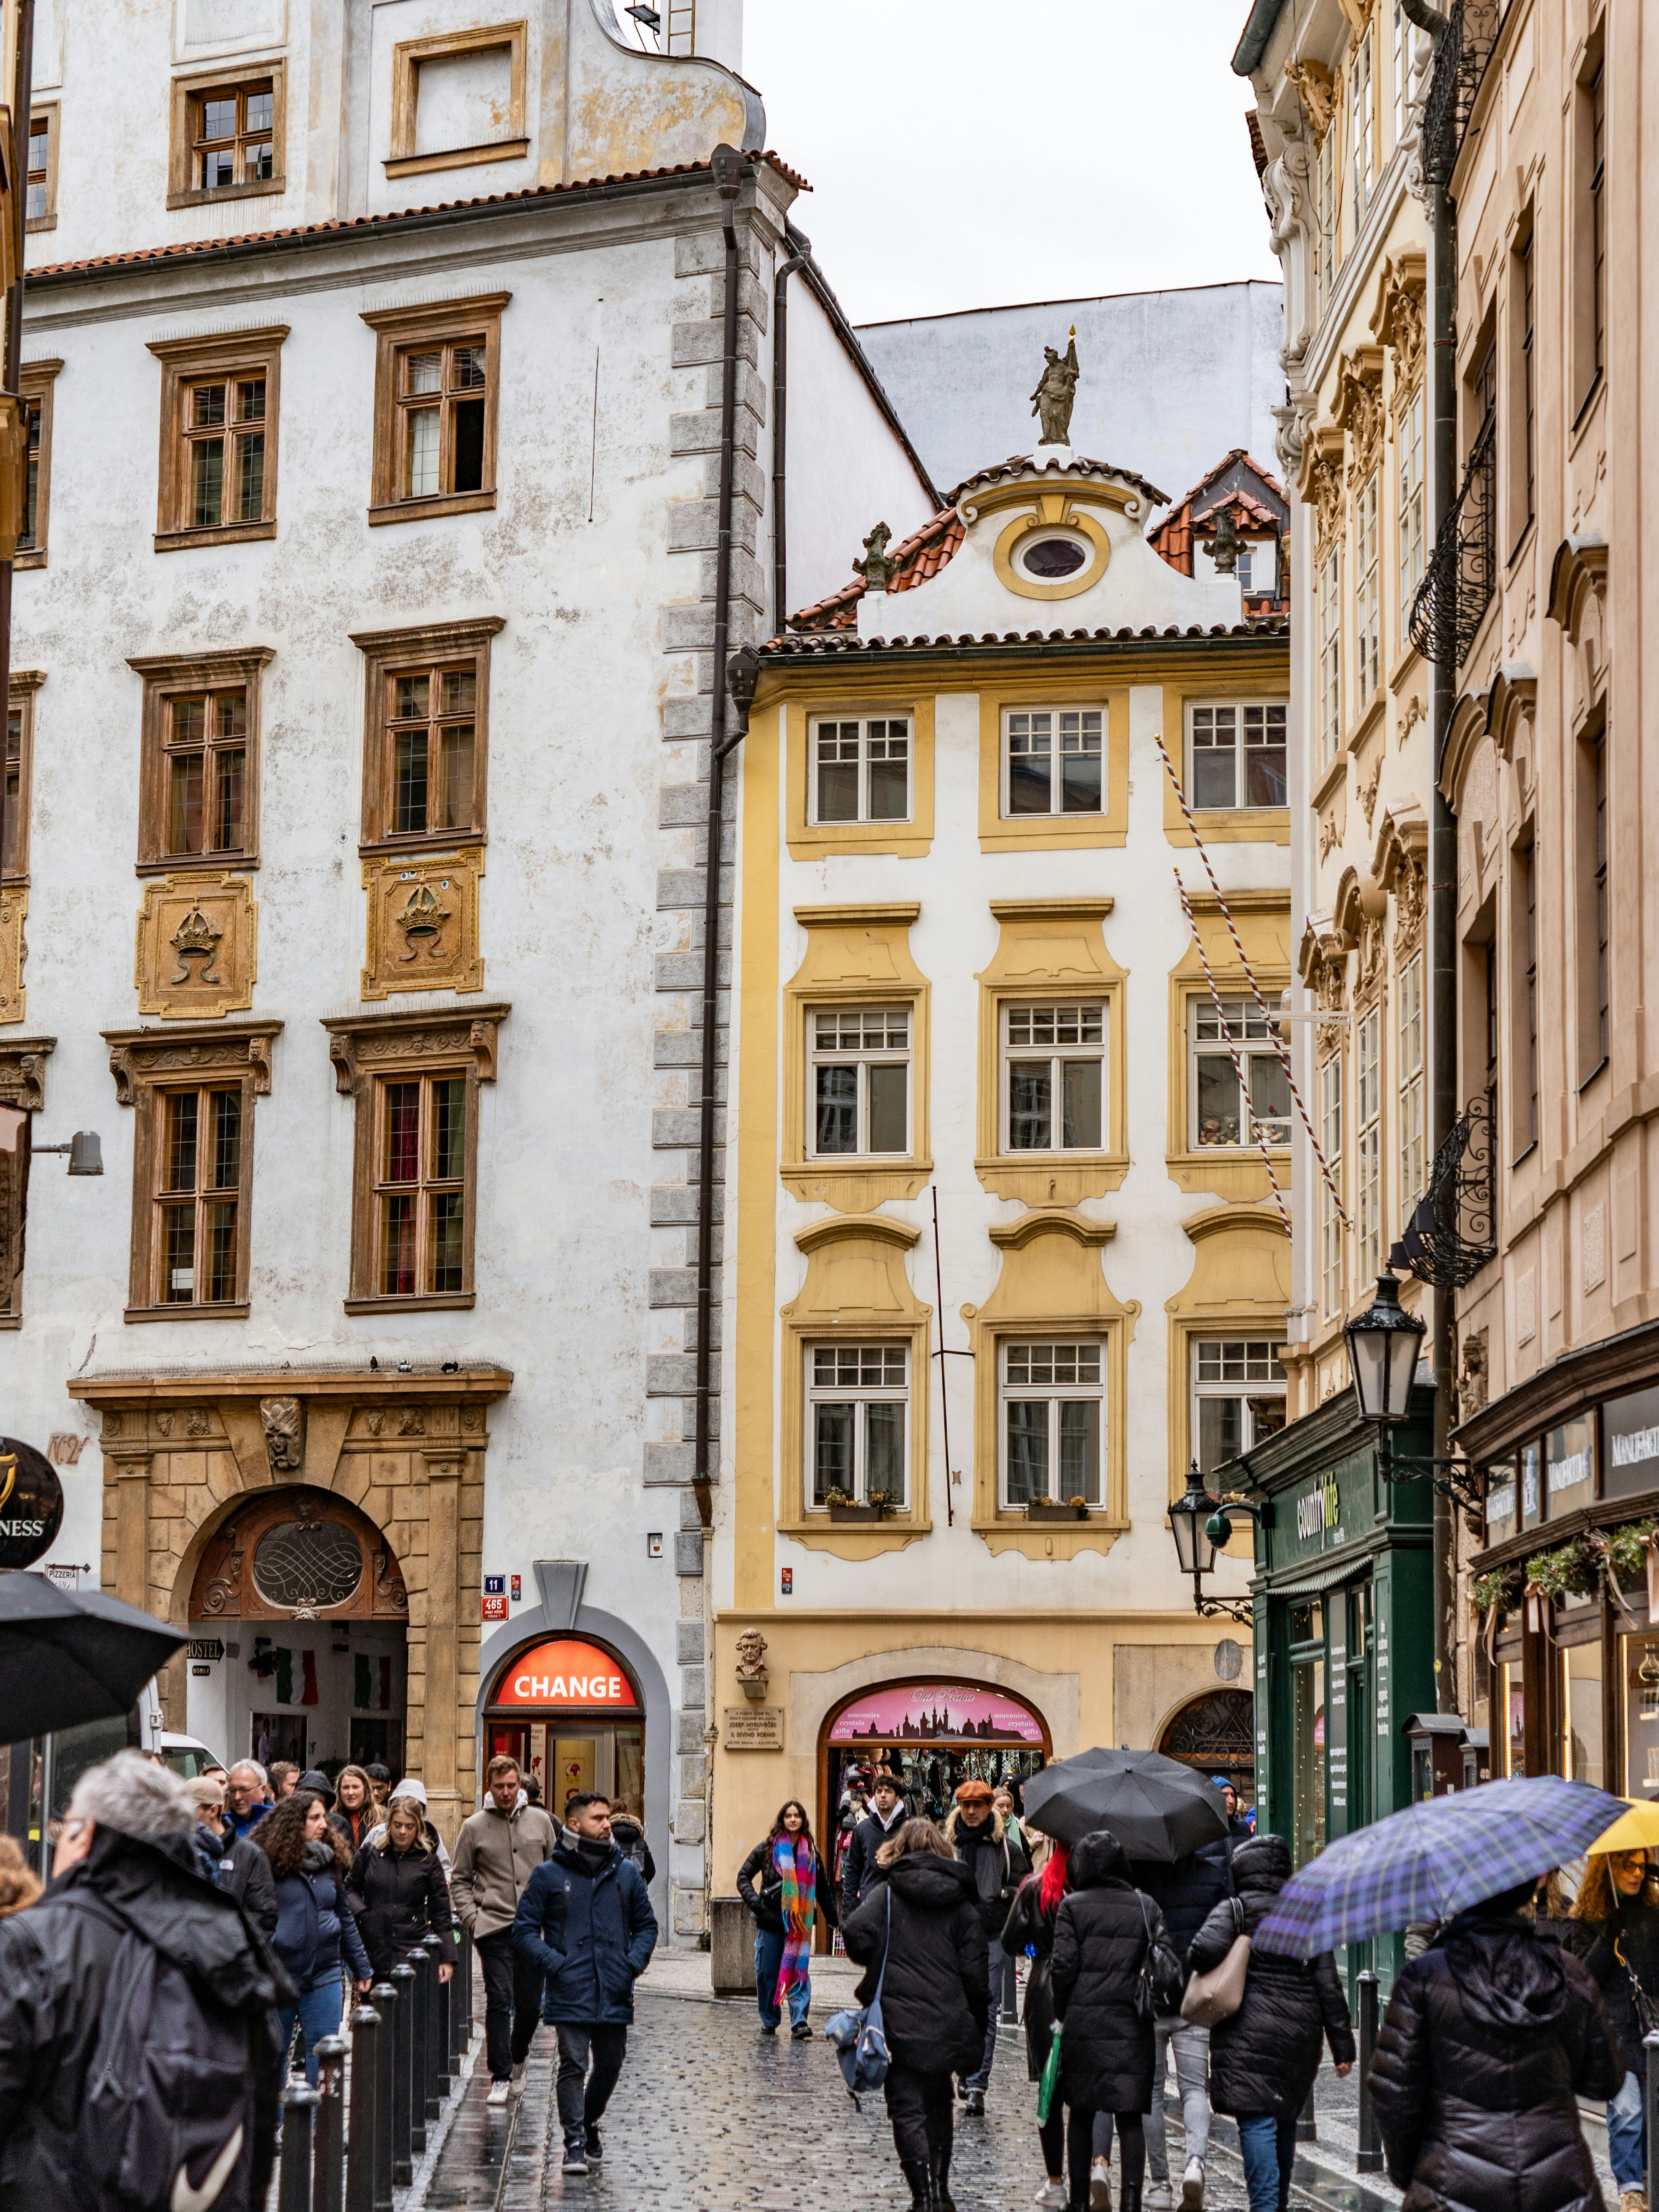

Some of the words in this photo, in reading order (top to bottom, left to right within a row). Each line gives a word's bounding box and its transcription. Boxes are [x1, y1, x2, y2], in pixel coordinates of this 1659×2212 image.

[490, 1580, 498, 1591] 11
[486, 1599, 502, 1610] 465
[515, 1676, 620, 1697] CHANGE
[910, 1687, 934, 1702] Old
[936, 1687, 975, 1702] Praha
